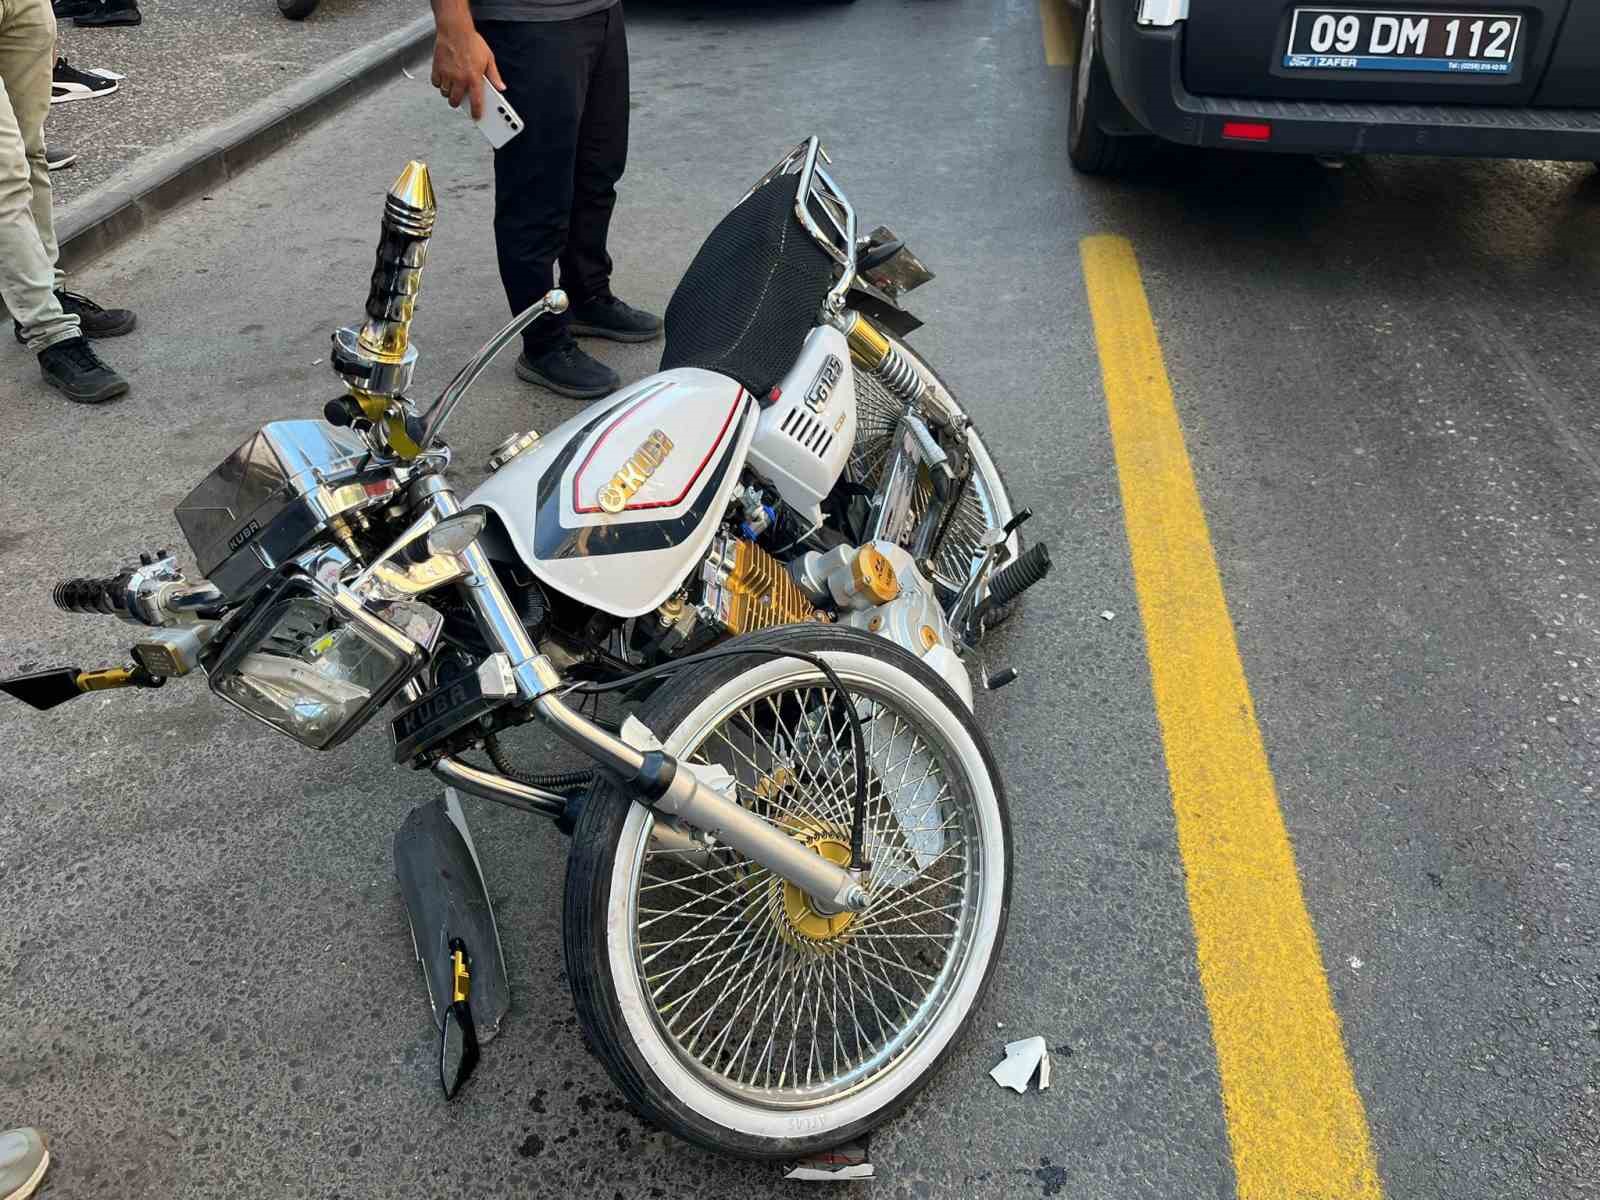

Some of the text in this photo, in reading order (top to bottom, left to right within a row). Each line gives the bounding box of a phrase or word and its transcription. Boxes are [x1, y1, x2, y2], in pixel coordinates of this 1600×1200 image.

[1310, 15, 1511, 58] 09 DM 112
[1318, 57, 1357, 67] ZAFER
[229, 520, 260, 549] KUBA
[403, 683, 466, 733] KUBA
